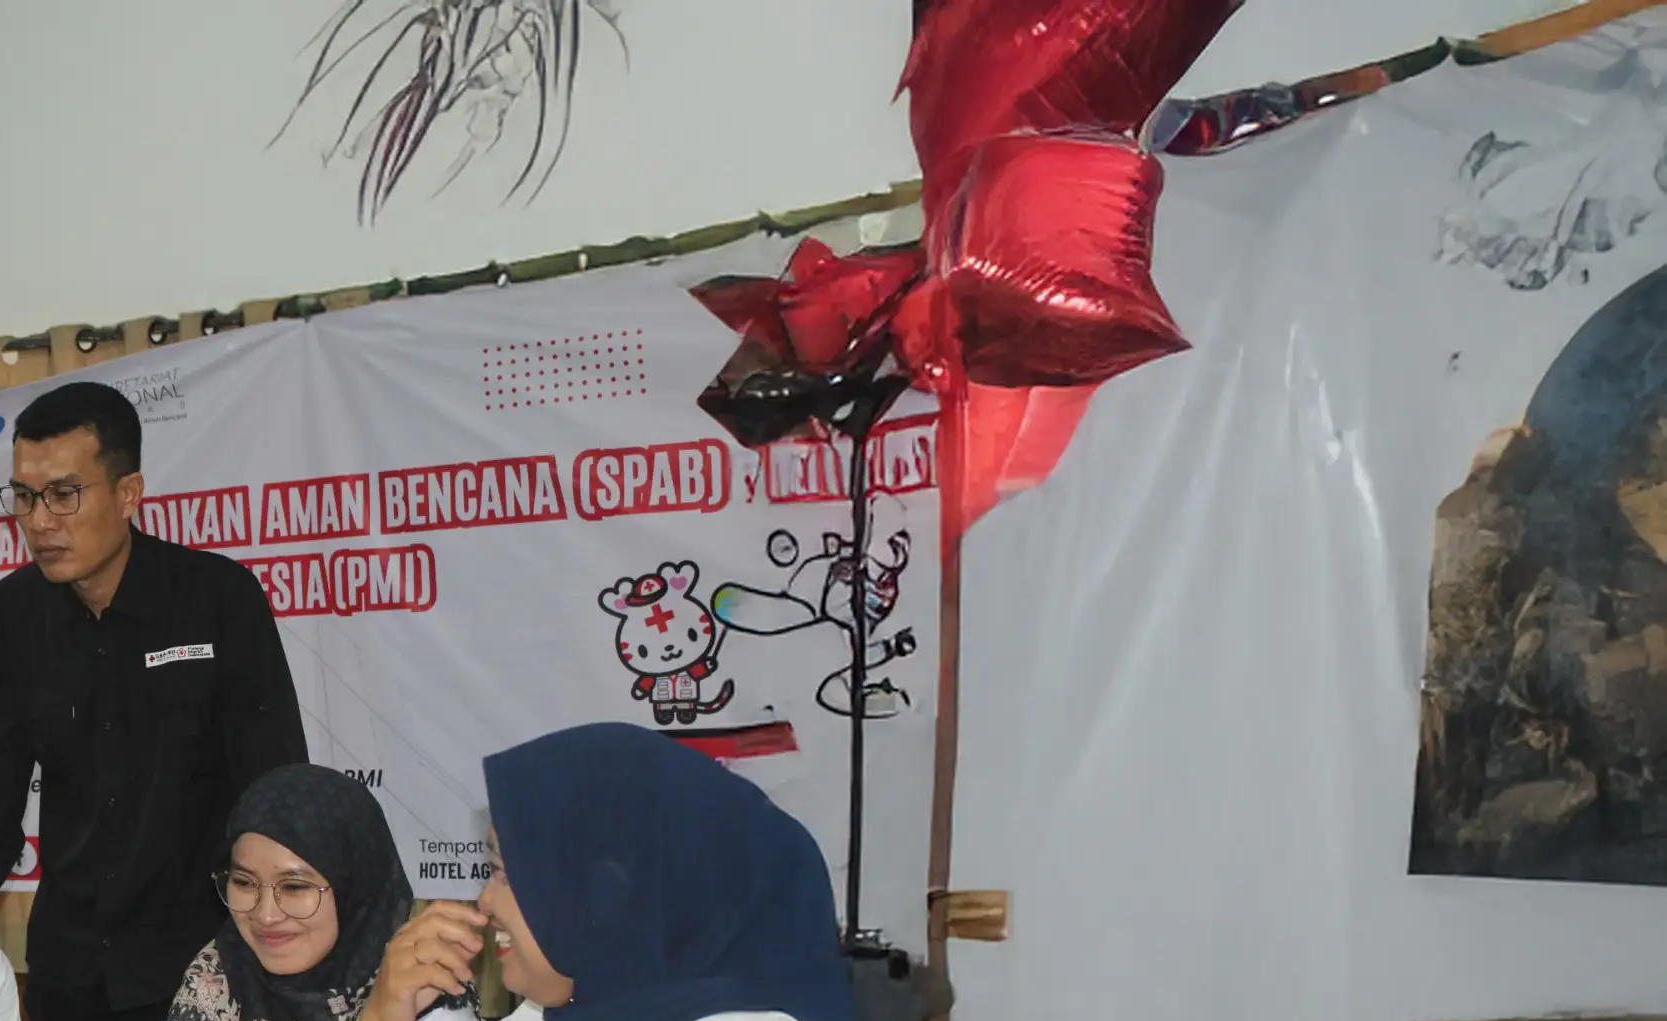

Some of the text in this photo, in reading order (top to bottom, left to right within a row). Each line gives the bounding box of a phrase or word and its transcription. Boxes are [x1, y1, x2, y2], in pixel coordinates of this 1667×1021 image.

[112, 367, 181, 393] RETARIAT
[127, 383, 185, 406] ONAL
[265, 479, 365, 539] AMAN
[384, 461, 560, 529] BENCANA
[579, 444, 724, 514] (SPAB)
[251, 558, 328, 611] ESIA
[333, 550, 431, 611] (PMI)
[419, 839, 484, 857] Tempat
[419, 862, 492, 880] HOTEL AG
